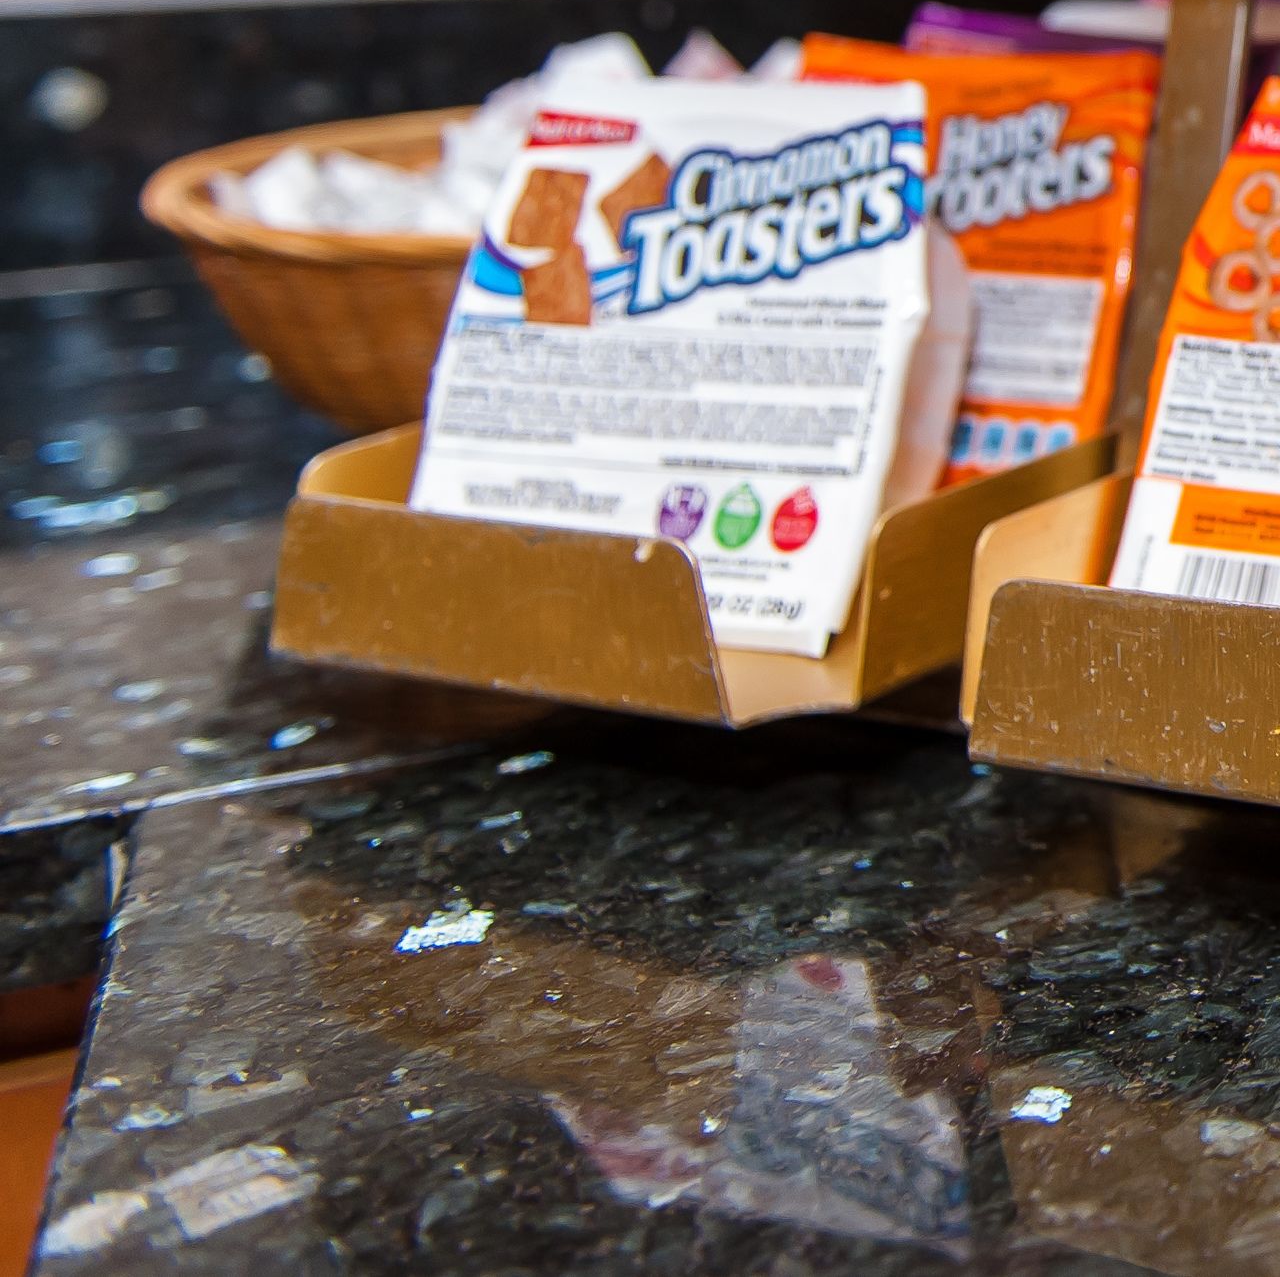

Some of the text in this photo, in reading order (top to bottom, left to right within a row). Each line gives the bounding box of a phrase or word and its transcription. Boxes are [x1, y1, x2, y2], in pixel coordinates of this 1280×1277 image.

[673, 122, 893, 222] Cinnamon
[926, 135, 1116, 232] cooters
[628, 168, 906, 311] Toasters
